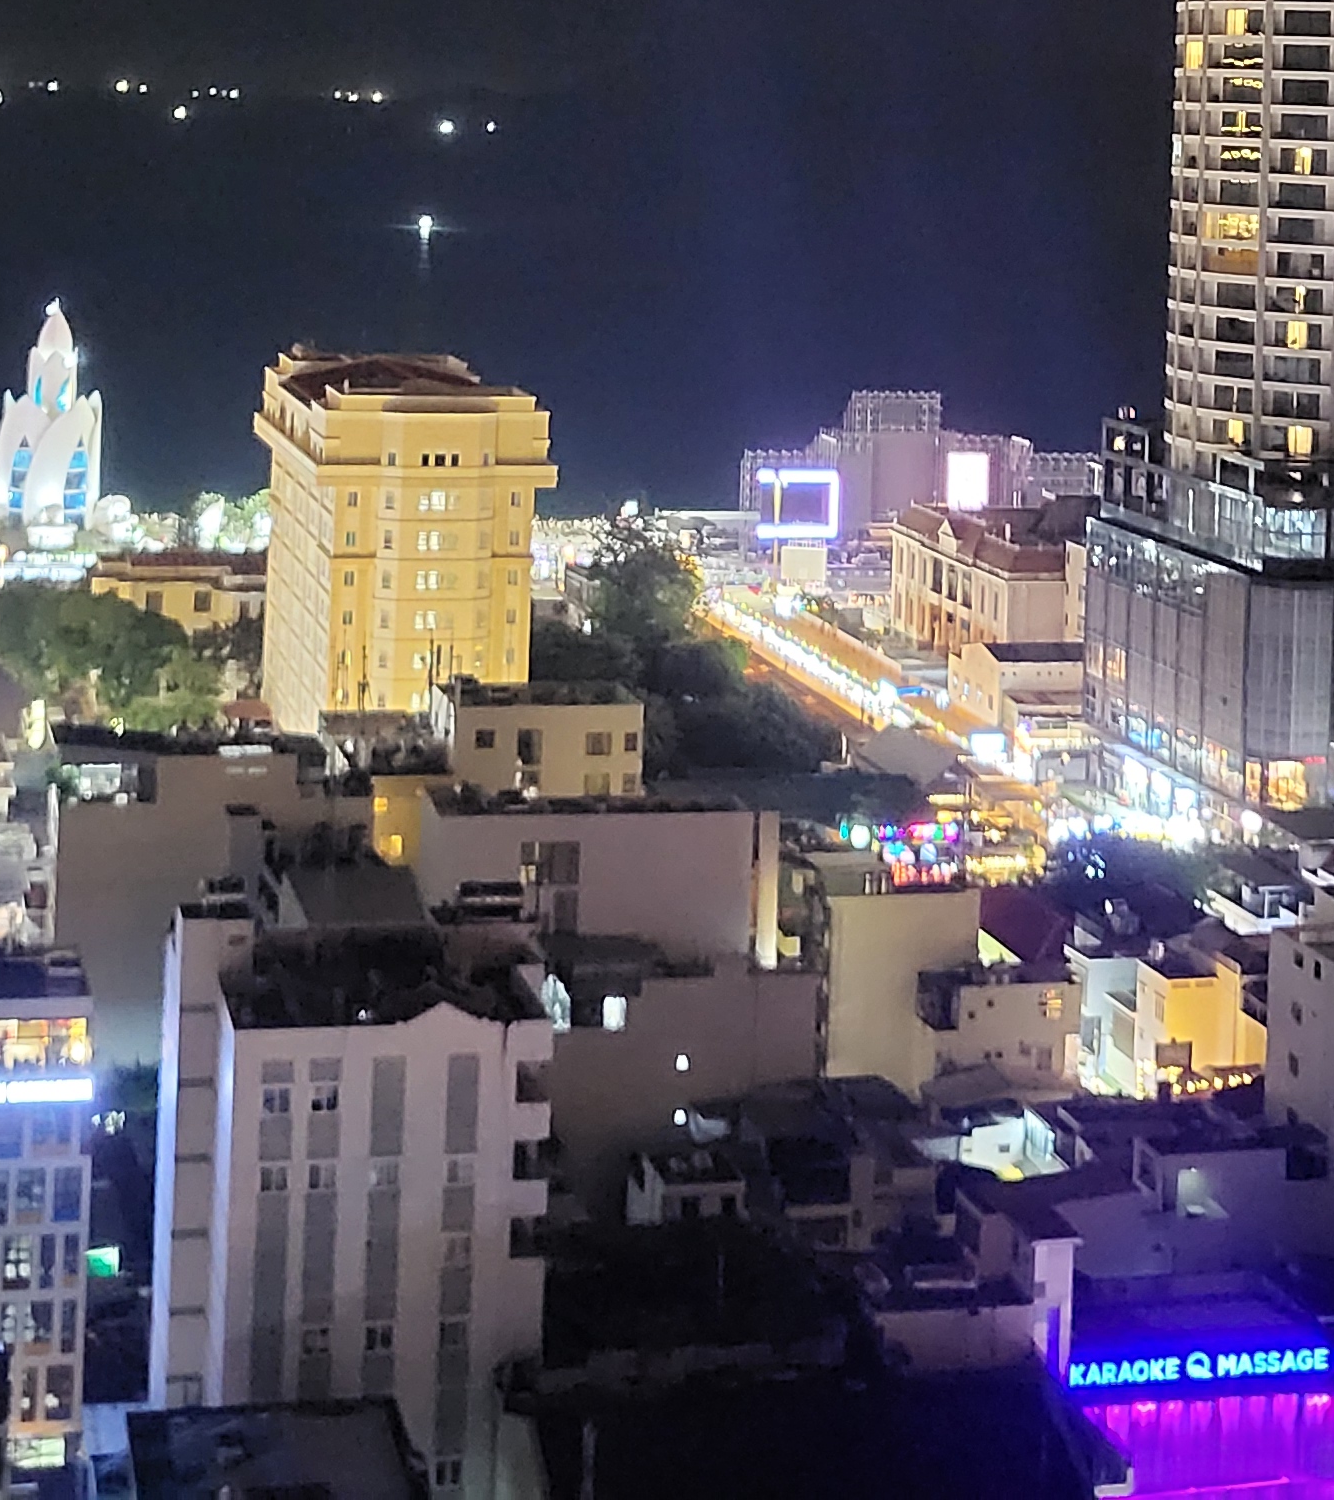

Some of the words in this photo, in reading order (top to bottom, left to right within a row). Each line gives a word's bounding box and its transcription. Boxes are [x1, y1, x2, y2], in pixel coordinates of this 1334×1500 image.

[1069, 1357, 1181, 1388] KARAOKE
[1186, 1351, 1214, 1380] Q
[1217, 1347, 1329, 1378] MASSAGE
